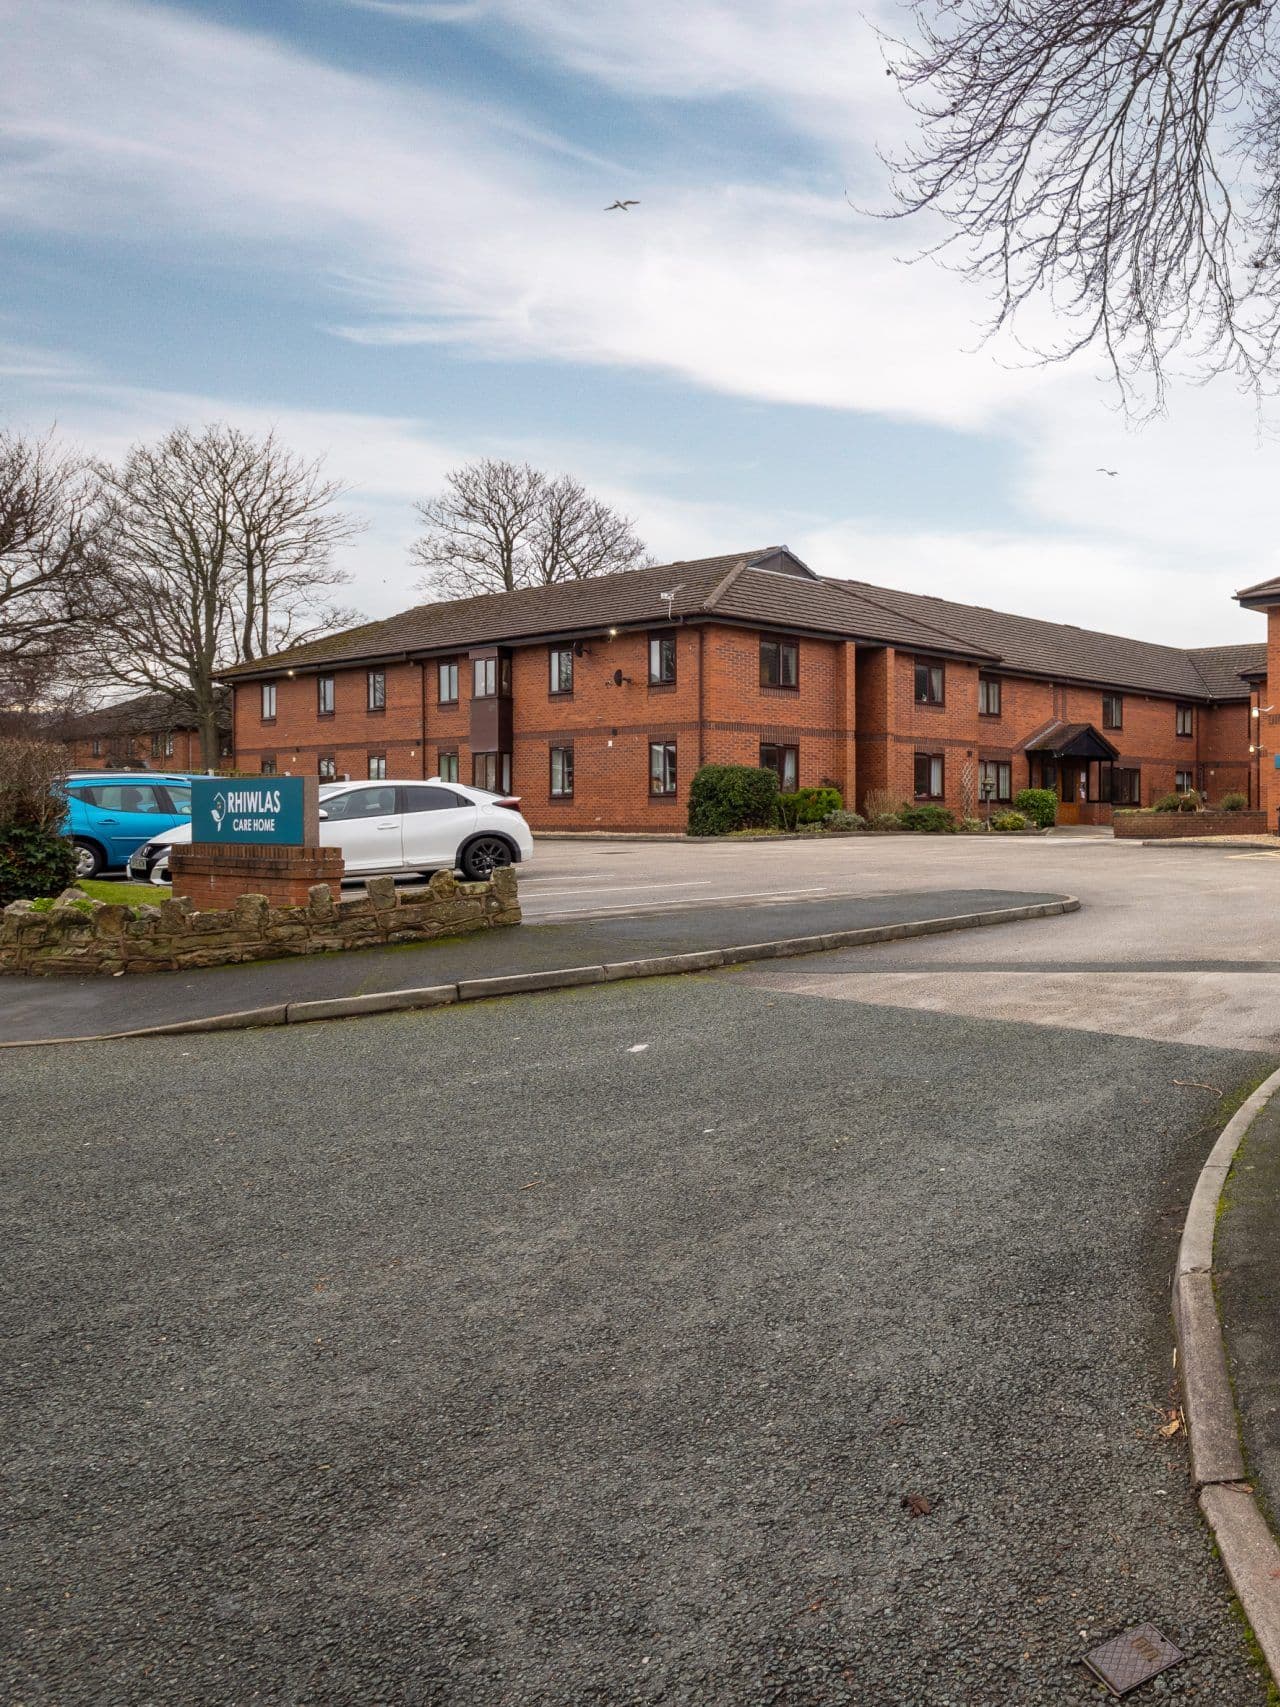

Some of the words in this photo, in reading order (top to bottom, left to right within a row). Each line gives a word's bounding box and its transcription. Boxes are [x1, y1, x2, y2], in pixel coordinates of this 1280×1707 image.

[227, 790, 281, 813] RHIWLAS
[232, 818, 251, 832] CARE
[253, 818, 275, 832] HOME
